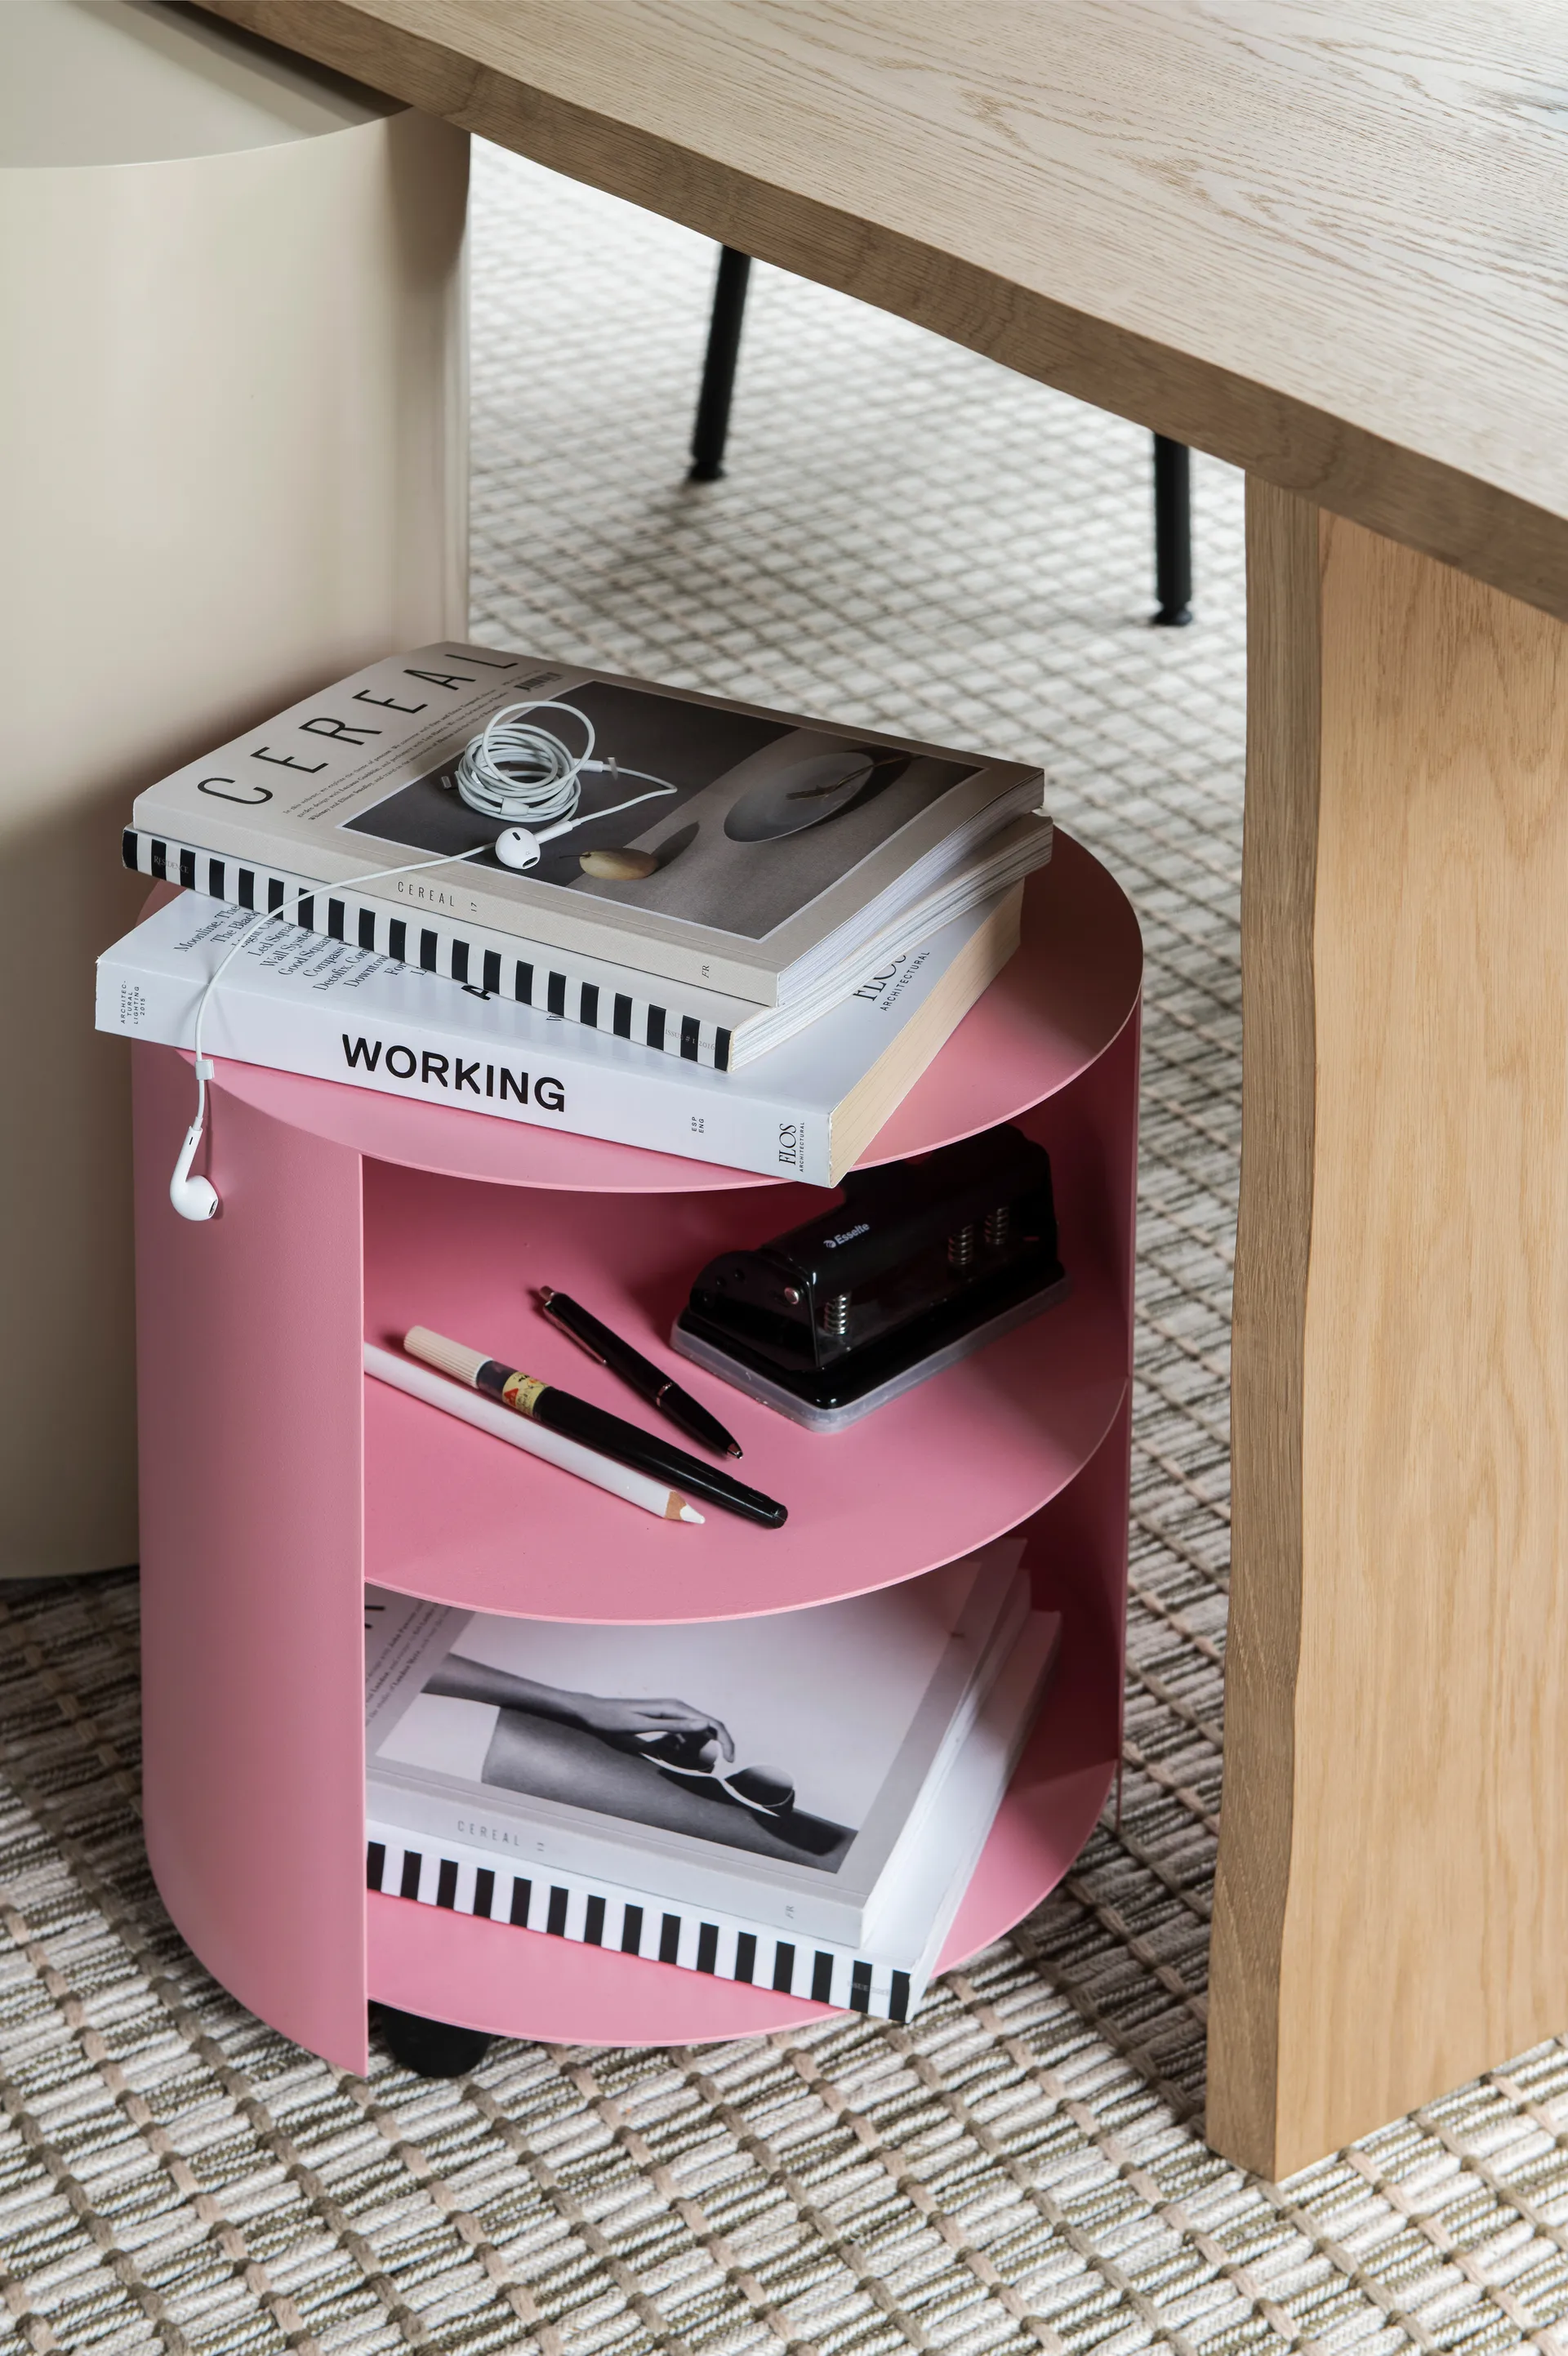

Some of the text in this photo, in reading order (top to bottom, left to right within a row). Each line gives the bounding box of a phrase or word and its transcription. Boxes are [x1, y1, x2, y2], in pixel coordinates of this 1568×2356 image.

[197, 653, 519, 804] CEREAL
[154, 855, 189, 874] RESIDENCE
[398, 881, 454, 906] CEREAL
[173, 906, 241, 951] Moonline, The
[211, 929, 234, 943] The
[247, 941, 274, 956] Led
[259, 950, 289, 967] Wall
[303, 946, 348, 977] Compass
[278, 956, 309, 975] Good
[312, 965, 356, 991] Decofix,
[880, 952, 930, 1011] ARCHITECTURAL
[341, 1033, 565, 1112] WORKING
[778, 1123, 797, 1165] FLOS
[834, 1223, 870, 1245] Esselte
[457, 1820, 519, 1846] CEREAL
